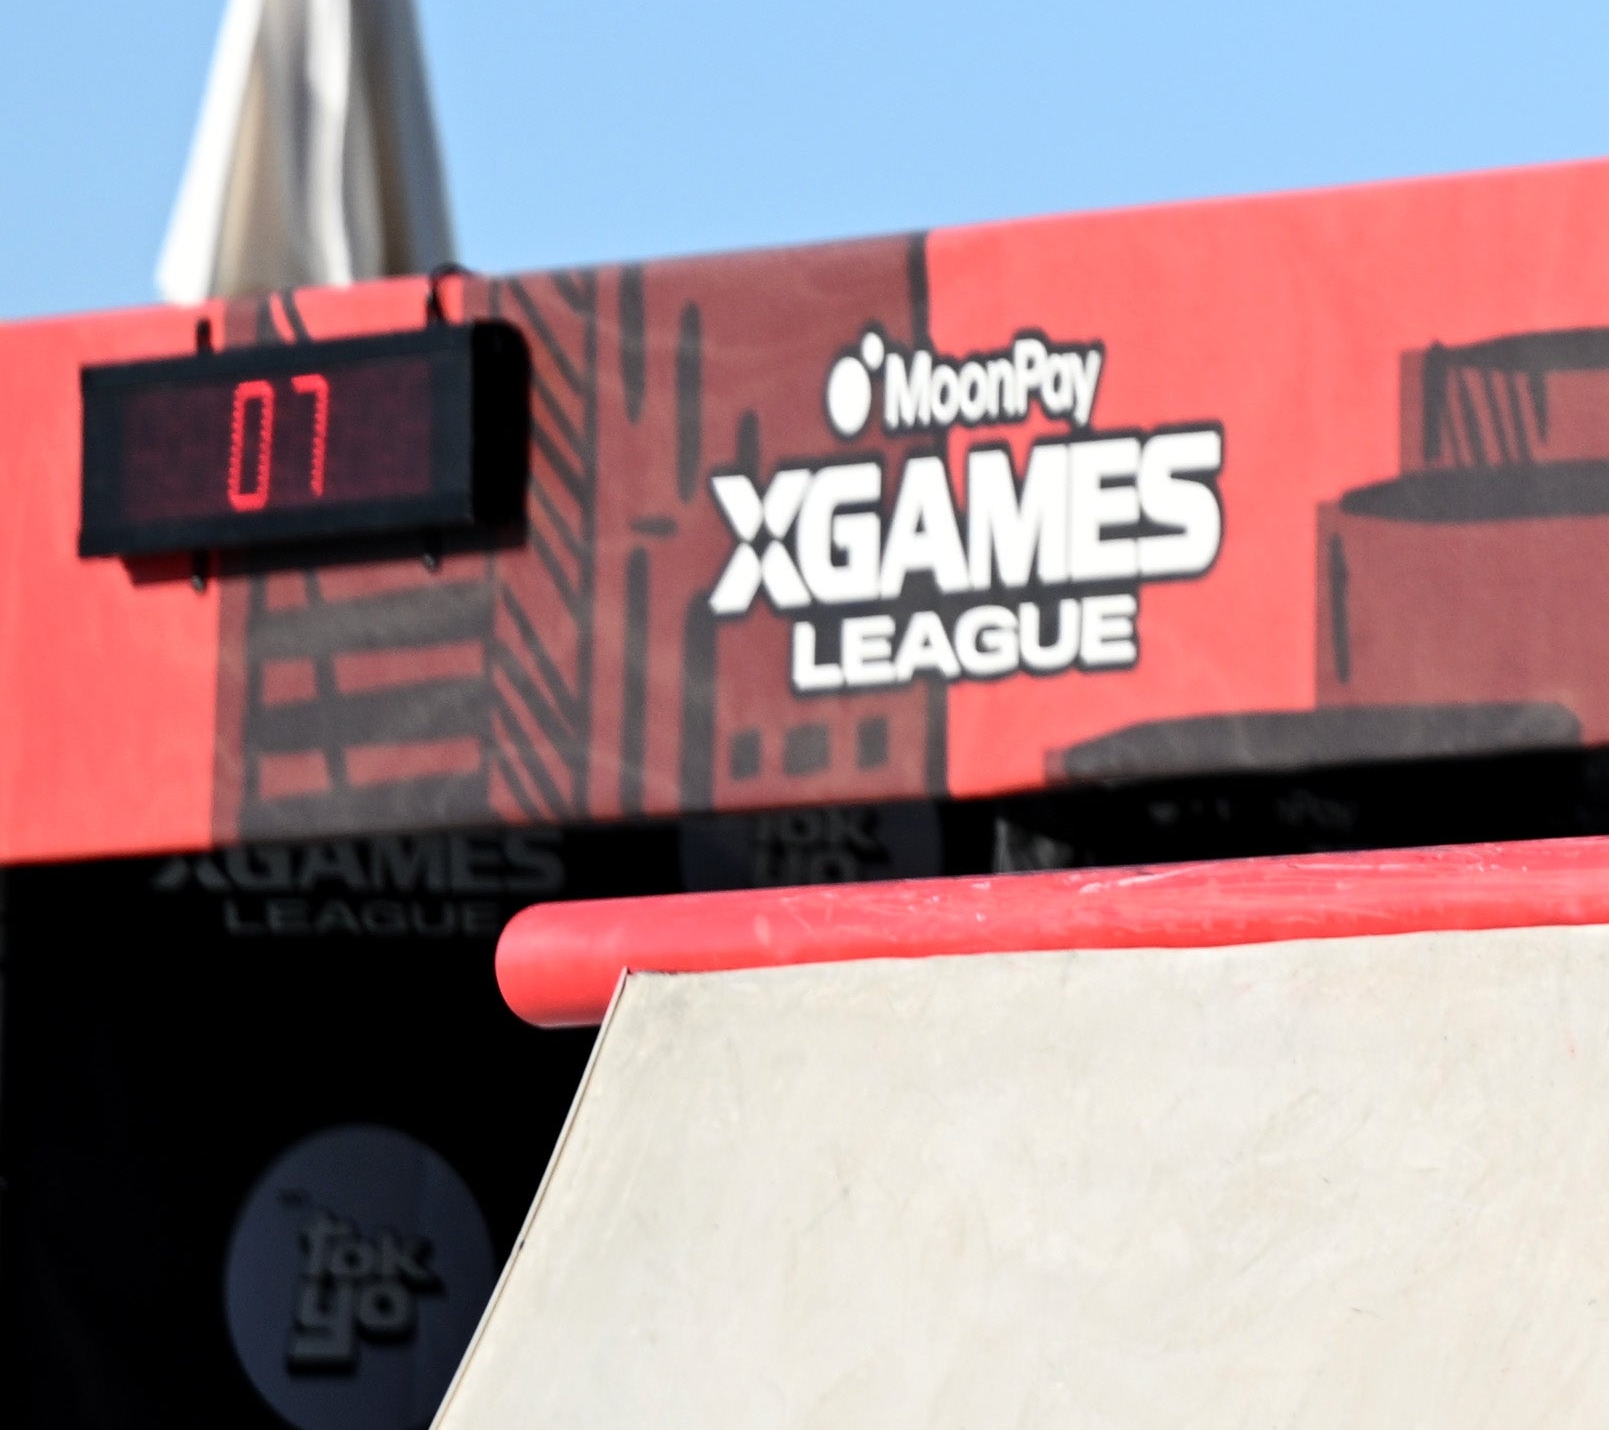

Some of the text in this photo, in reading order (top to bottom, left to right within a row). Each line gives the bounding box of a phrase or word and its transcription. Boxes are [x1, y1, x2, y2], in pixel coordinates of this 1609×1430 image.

[884, 338, 1102, 427] MoonPay
[228, 373, 329, 512] 07
[792, 594, 1137, 690] LEAGUE
[221, 898, 500, 939] LEAGUE
